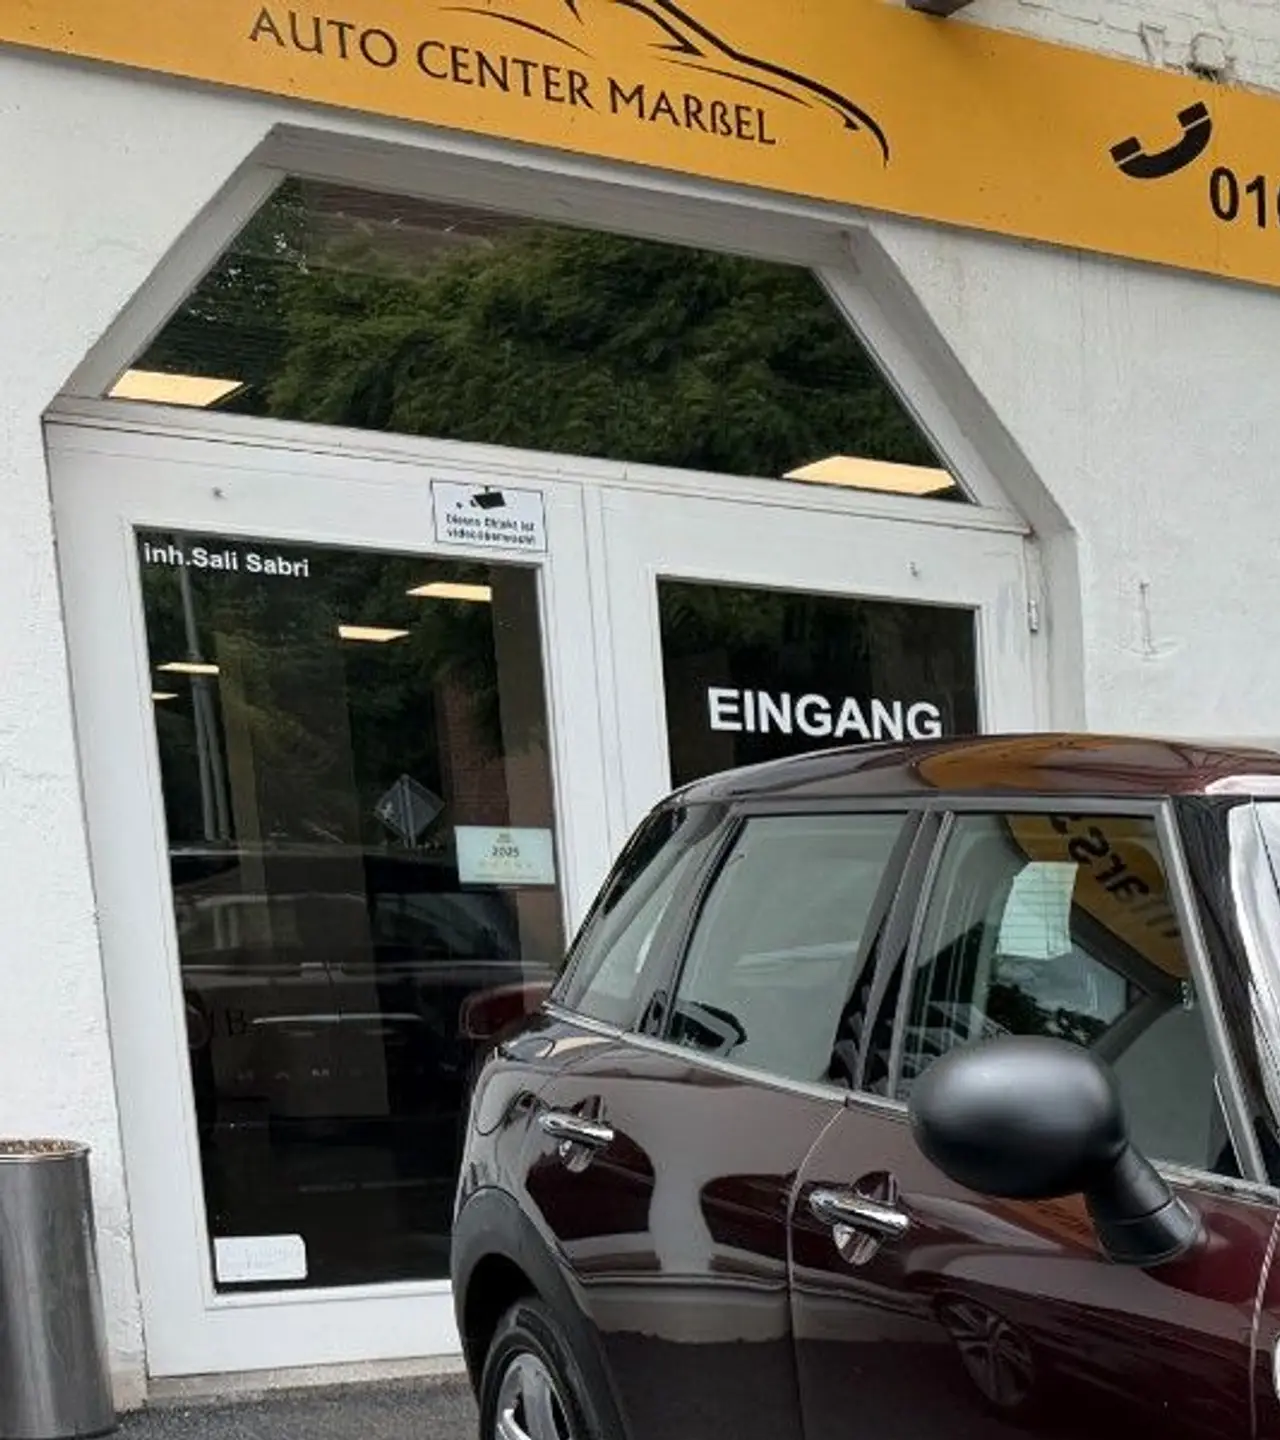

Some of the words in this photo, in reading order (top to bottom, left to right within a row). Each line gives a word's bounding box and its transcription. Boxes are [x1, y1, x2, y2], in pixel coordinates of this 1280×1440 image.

[248, 6, 398, 70] AUTO
[416, 39, 601, 114] CENTER
[245, 552, 310, 578] Sabri
[707, 686, 943, 741] EINGANG
